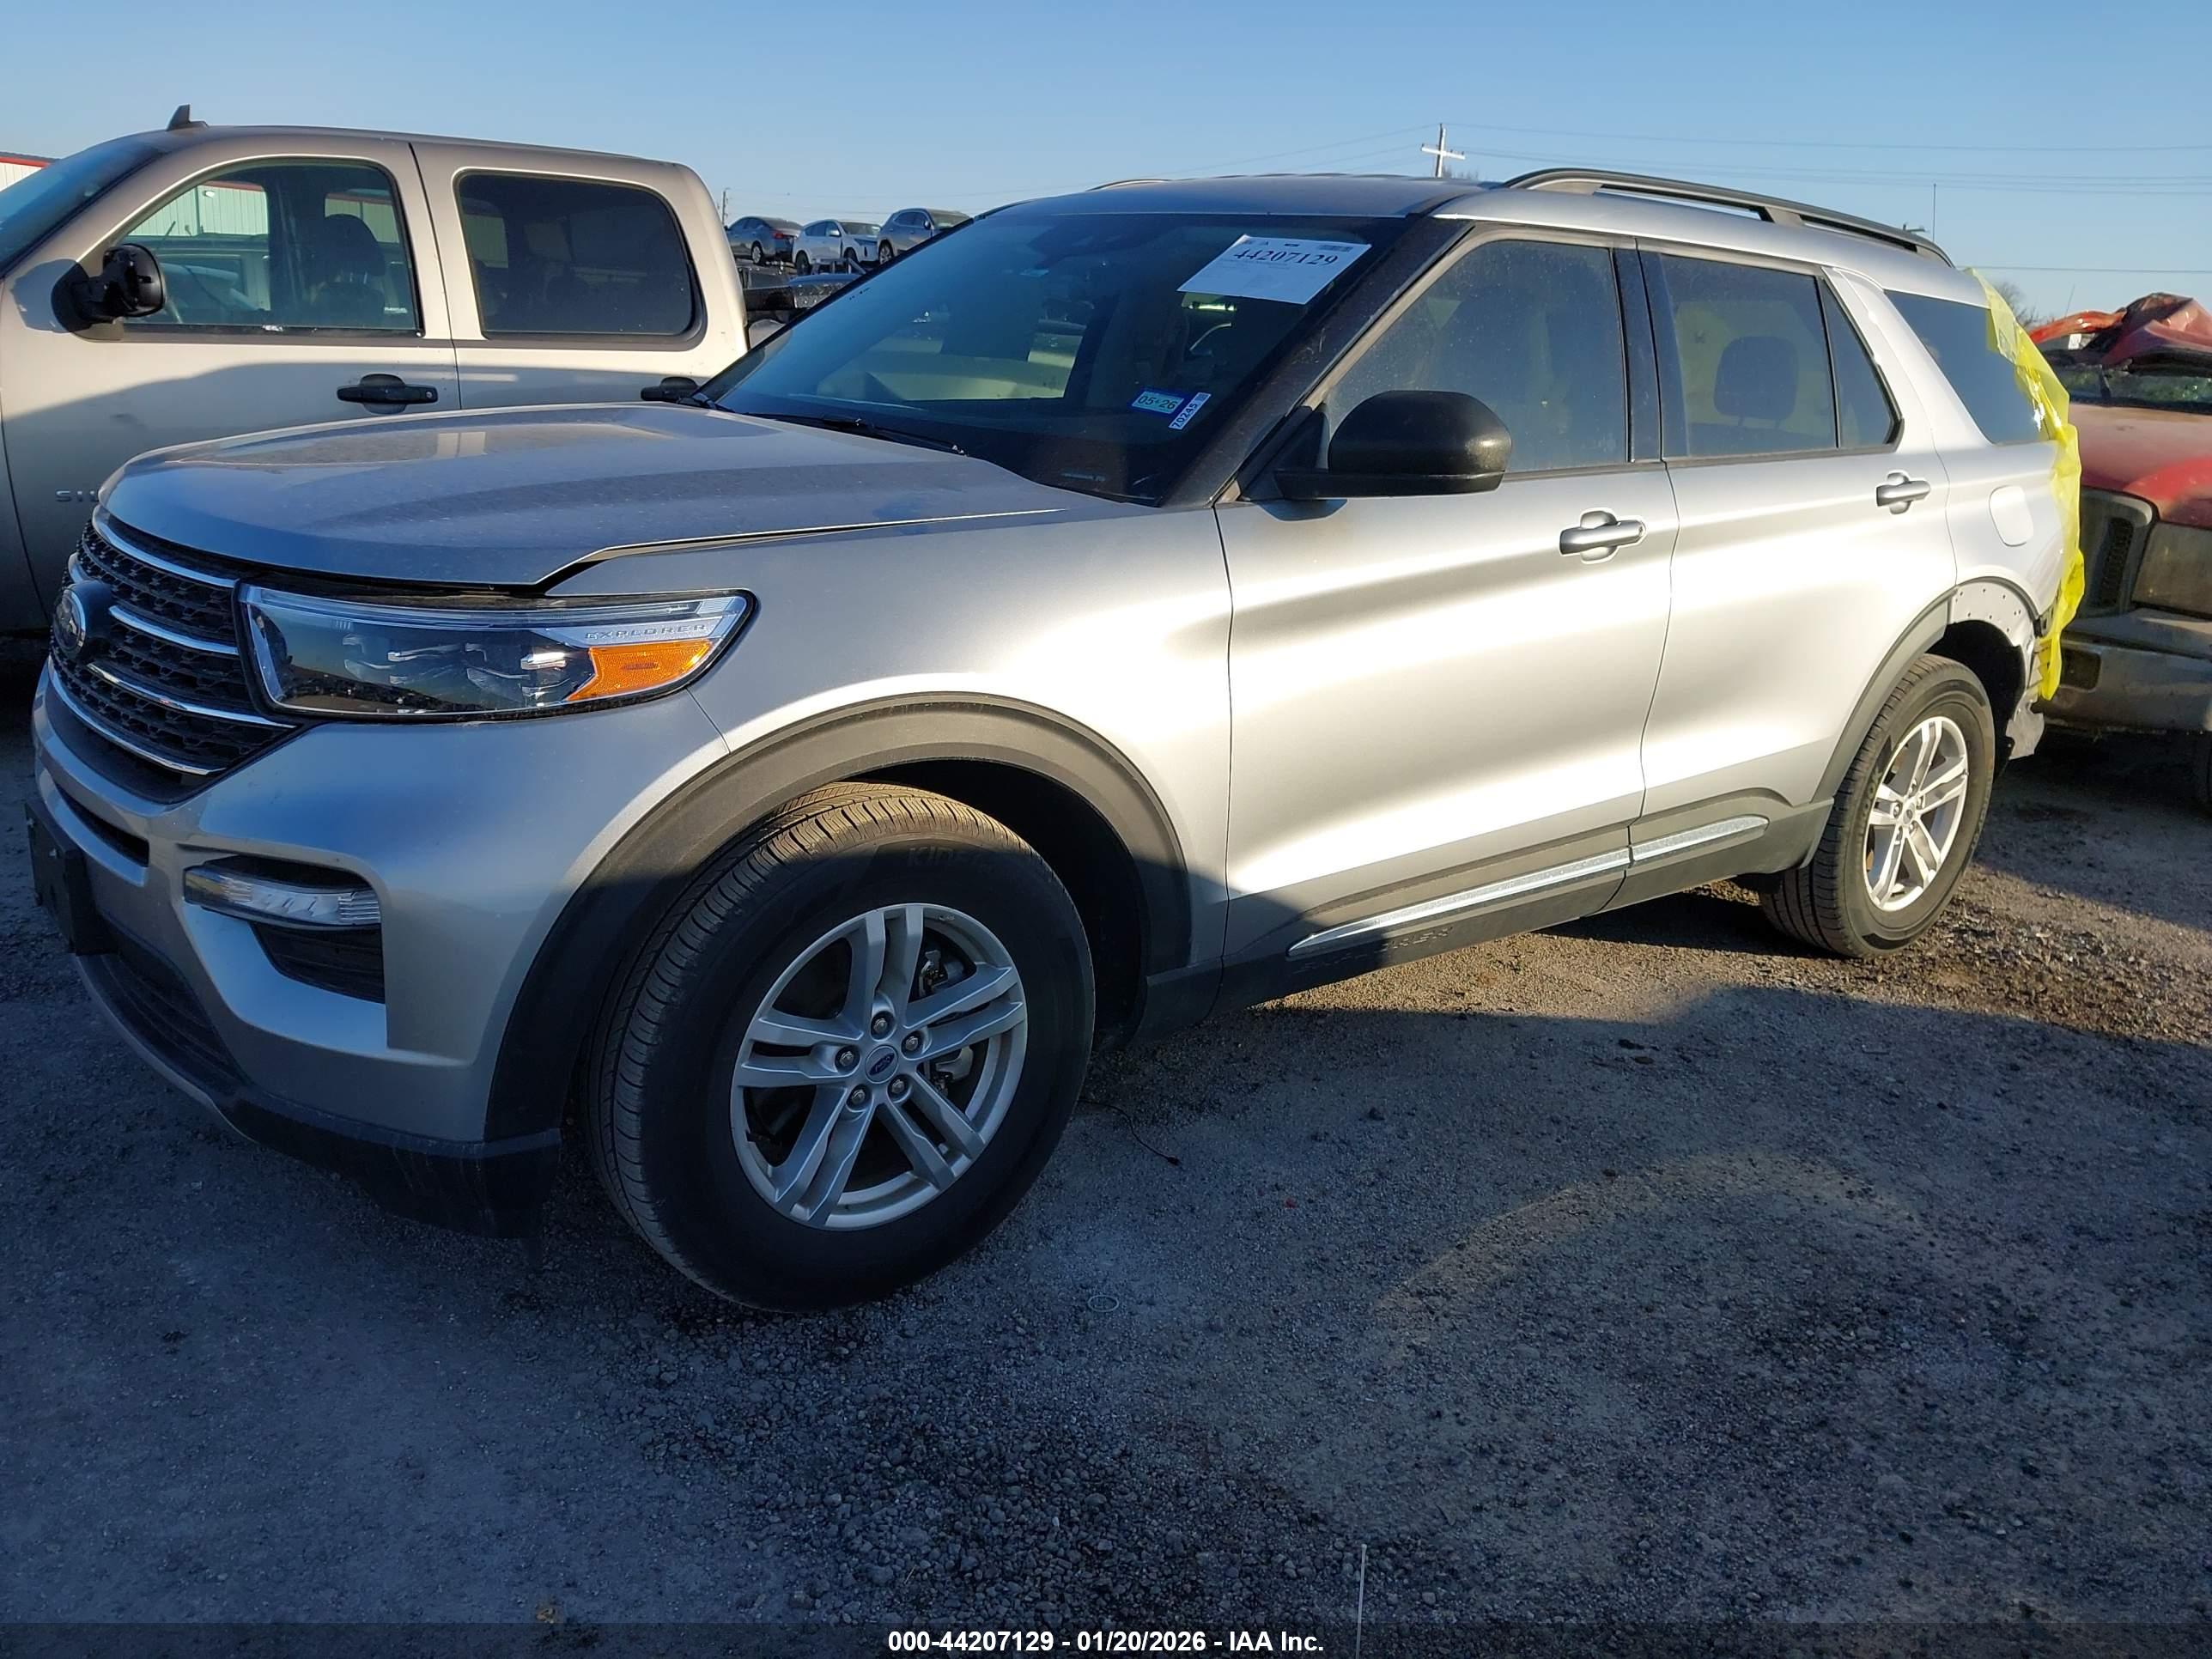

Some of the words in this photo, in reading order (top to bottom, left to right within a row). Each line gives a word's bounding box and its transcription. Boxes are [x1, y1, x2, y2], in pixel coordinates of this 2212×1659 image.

[1233, 249, 1338, 265] 44207129
[1137, 395, 1157, 405] 05
[1158, 399, 1179, 410] 26
[585, 624, 707, 639] EXPLORER
